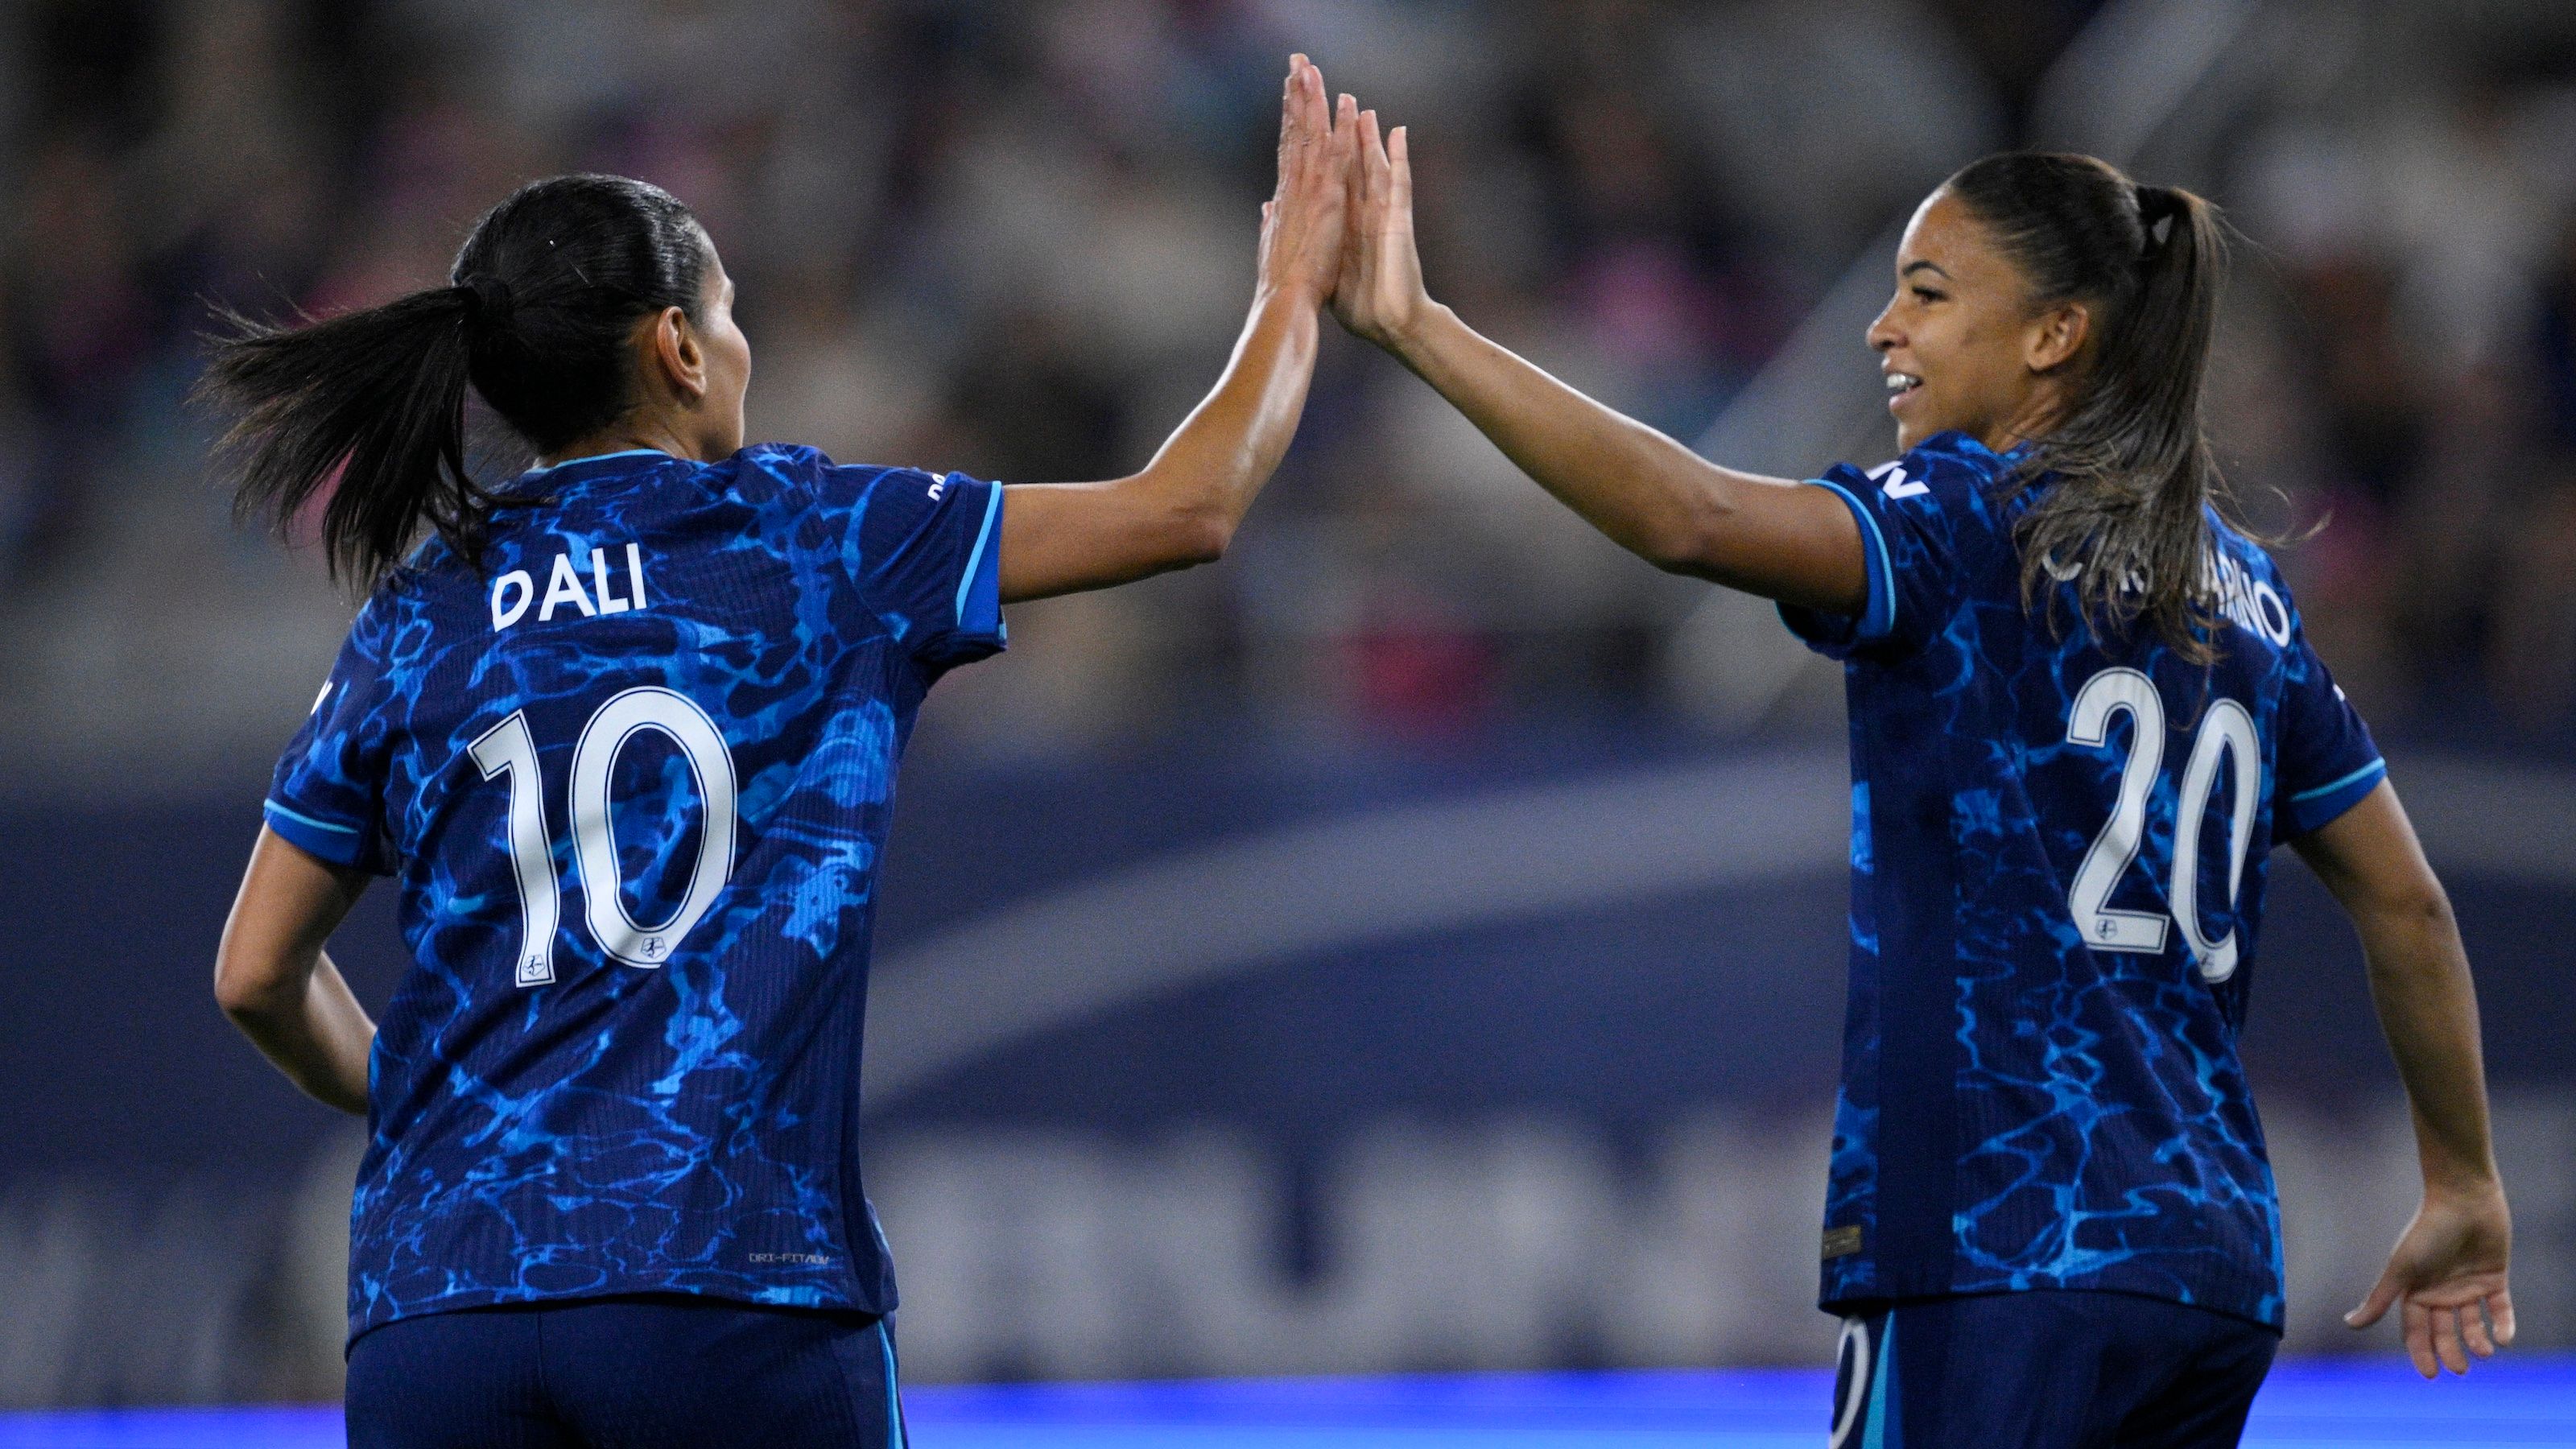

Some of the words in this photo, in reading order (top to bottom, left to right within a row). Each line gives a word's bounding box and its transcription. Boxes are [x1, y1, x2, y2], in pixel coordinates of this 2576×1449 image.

[491, 542, 647, 633] DALI
[467, 685, 738, 988] 10
[2066, 667, 2262, 984] 20
